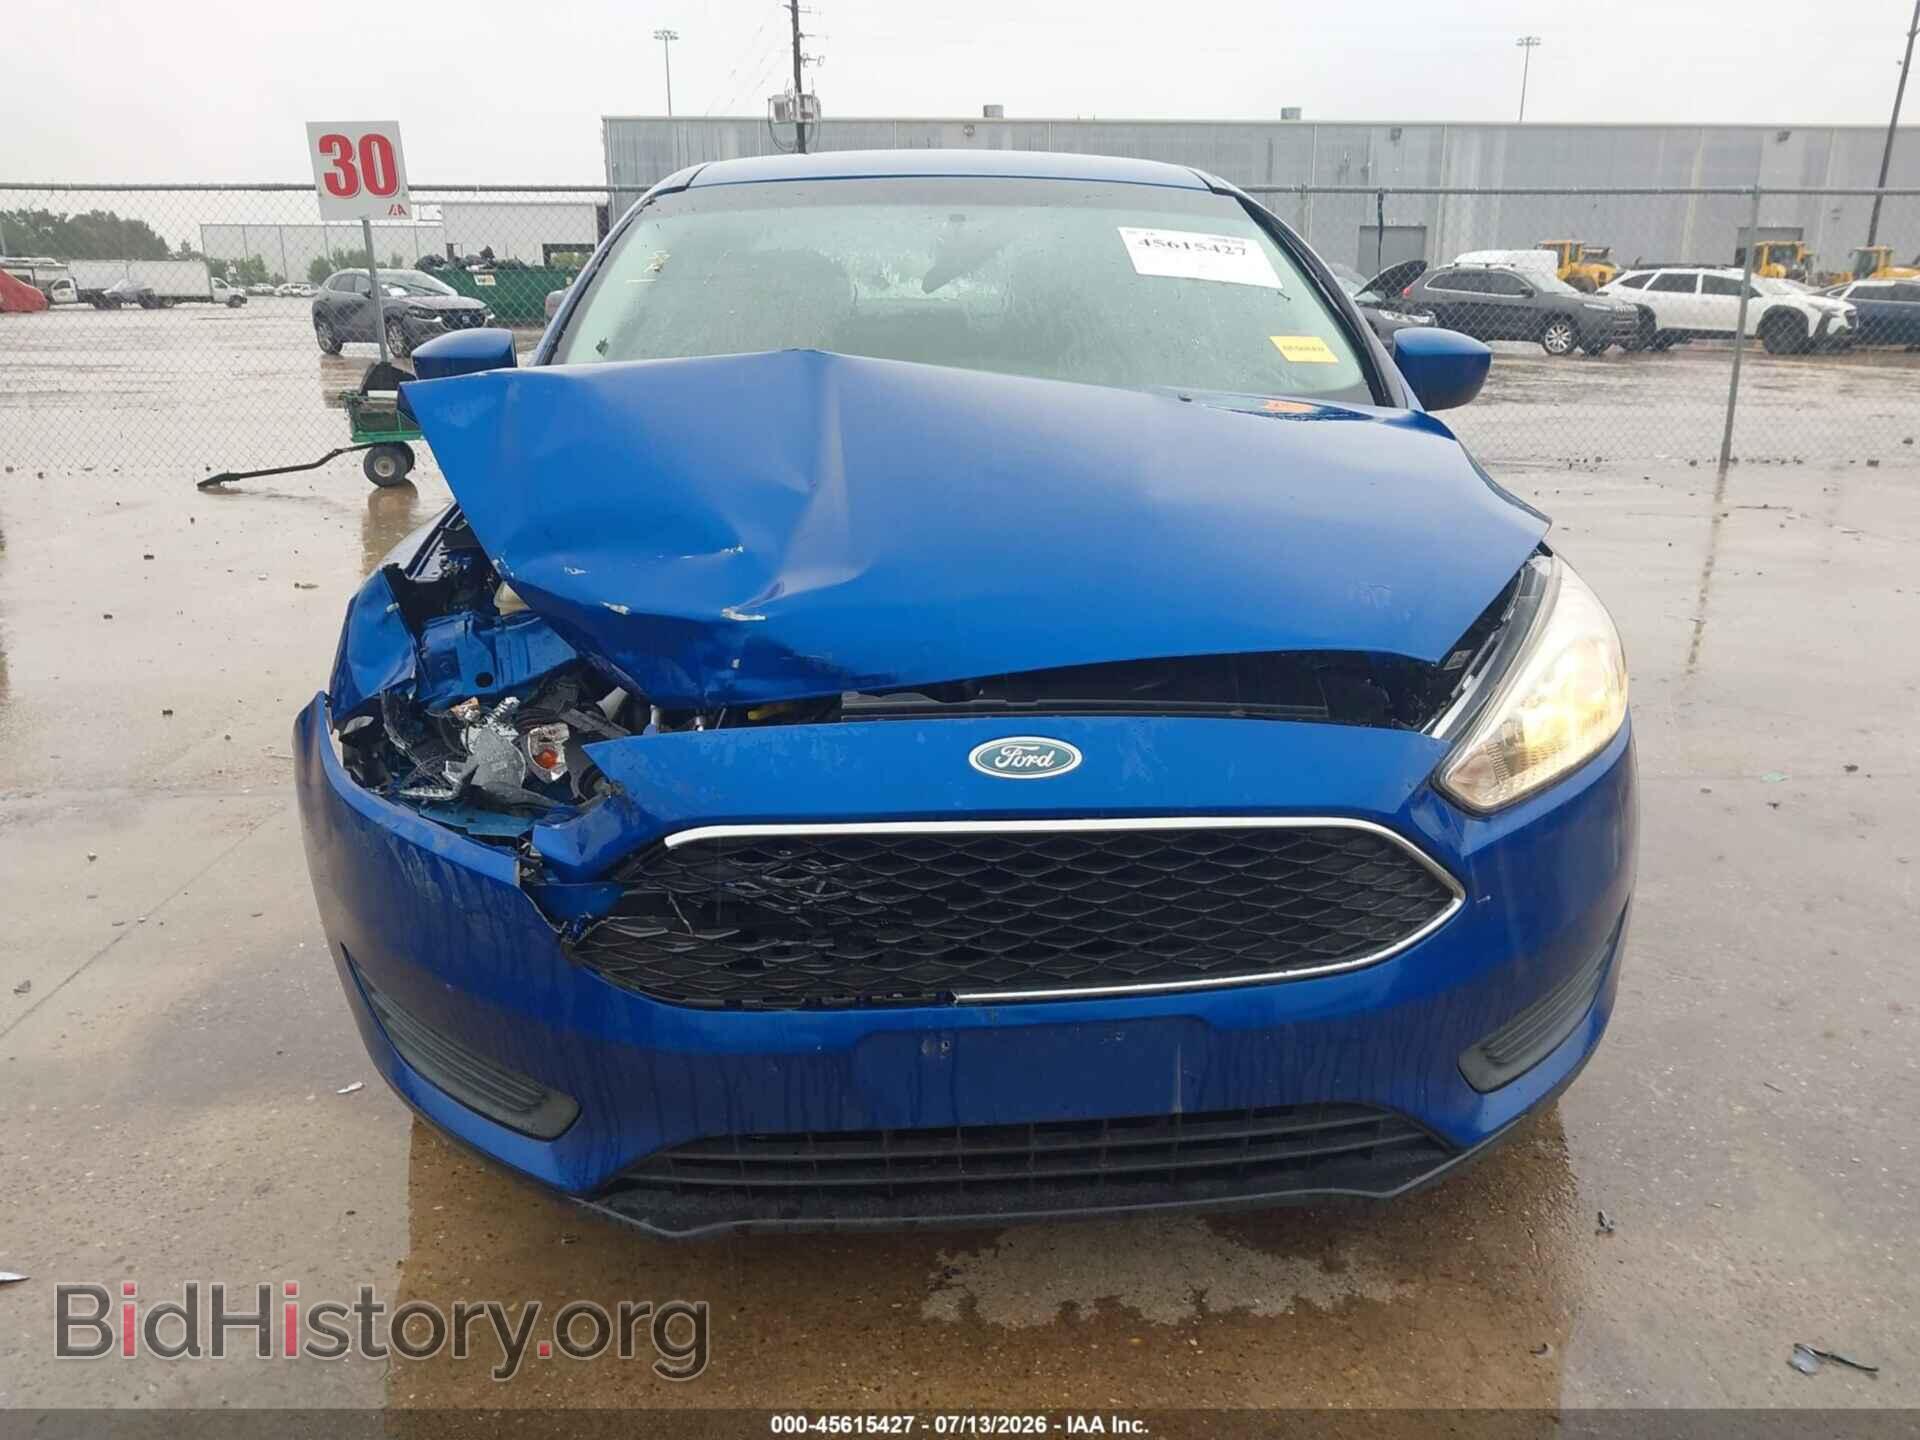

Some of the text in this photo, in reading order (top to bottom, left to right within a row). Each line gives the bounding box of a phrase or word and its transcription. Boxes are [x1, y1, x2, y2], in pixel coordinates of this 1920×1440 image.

[319, 133, 399, 198] 30
[1138, 238, 1247, 256] 45615427
[995, 744, 1055, 768] Ford
